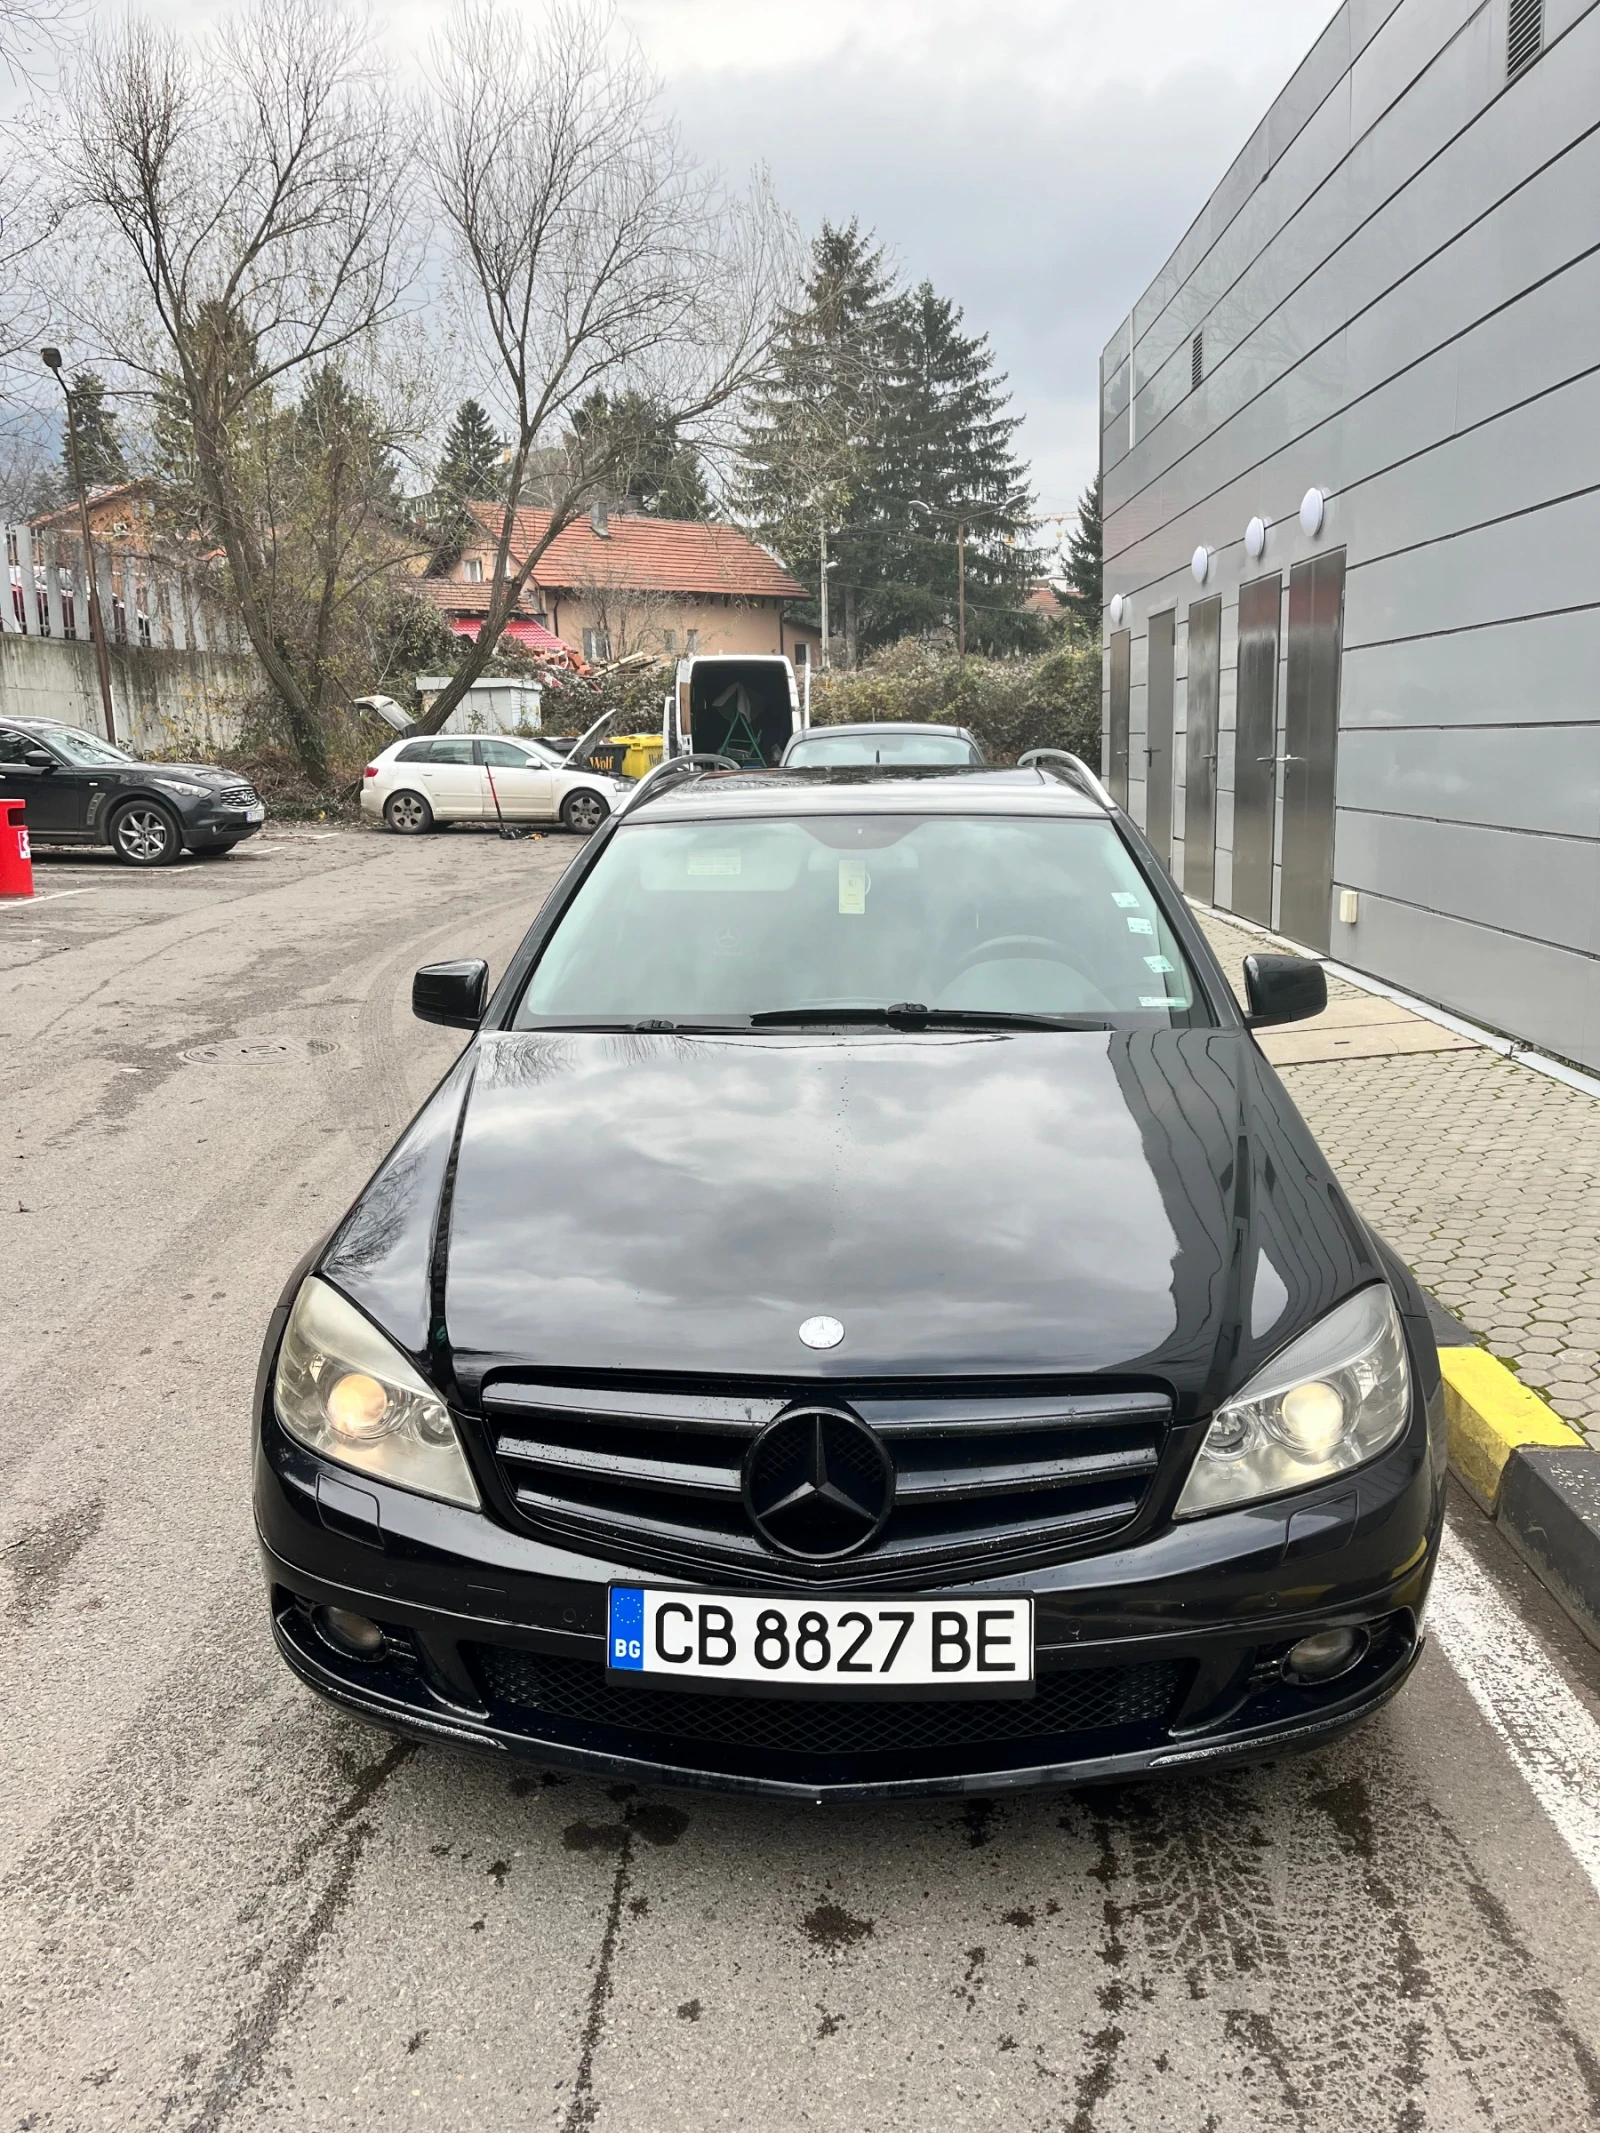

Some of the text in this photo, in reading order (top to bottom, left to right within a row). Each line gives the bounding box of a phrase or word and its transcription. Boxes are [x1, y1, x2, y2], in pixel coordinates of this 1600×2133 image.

[589, 756, 614, 770] Wolf
[655, 1602, 1016, 1673] CB 8827 BE
[614, 1638, 641, 1660] BG
